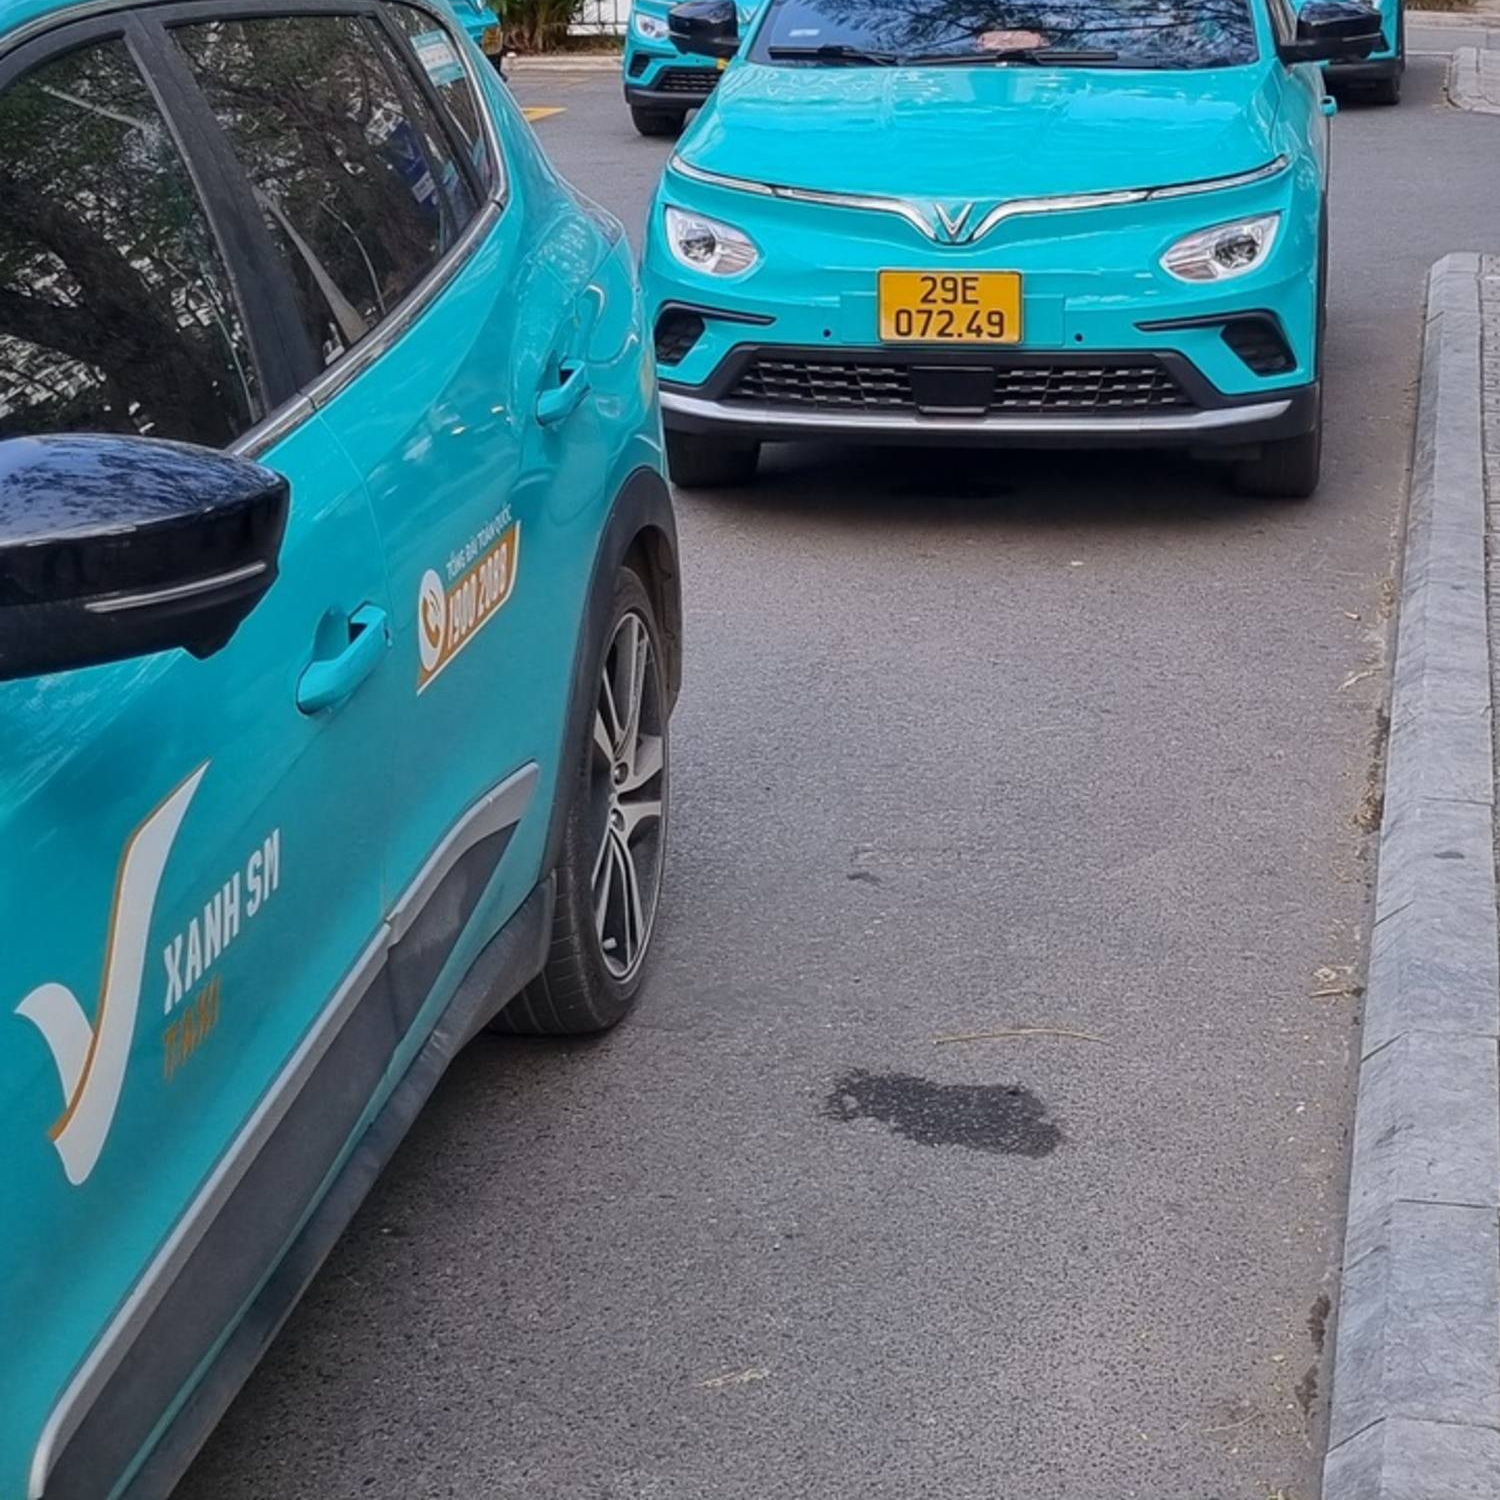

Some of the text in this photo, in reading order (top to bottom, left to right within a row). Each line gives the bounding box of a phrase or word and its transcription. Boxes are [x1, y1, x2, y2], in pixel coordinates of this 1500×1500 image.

[894, 308, 1005, 339] 072.49
[920, 275, 980, 305] 29E
[163, 828, 281, 1016] XANH SM
[162, 972, 222, 1082] TAXI
